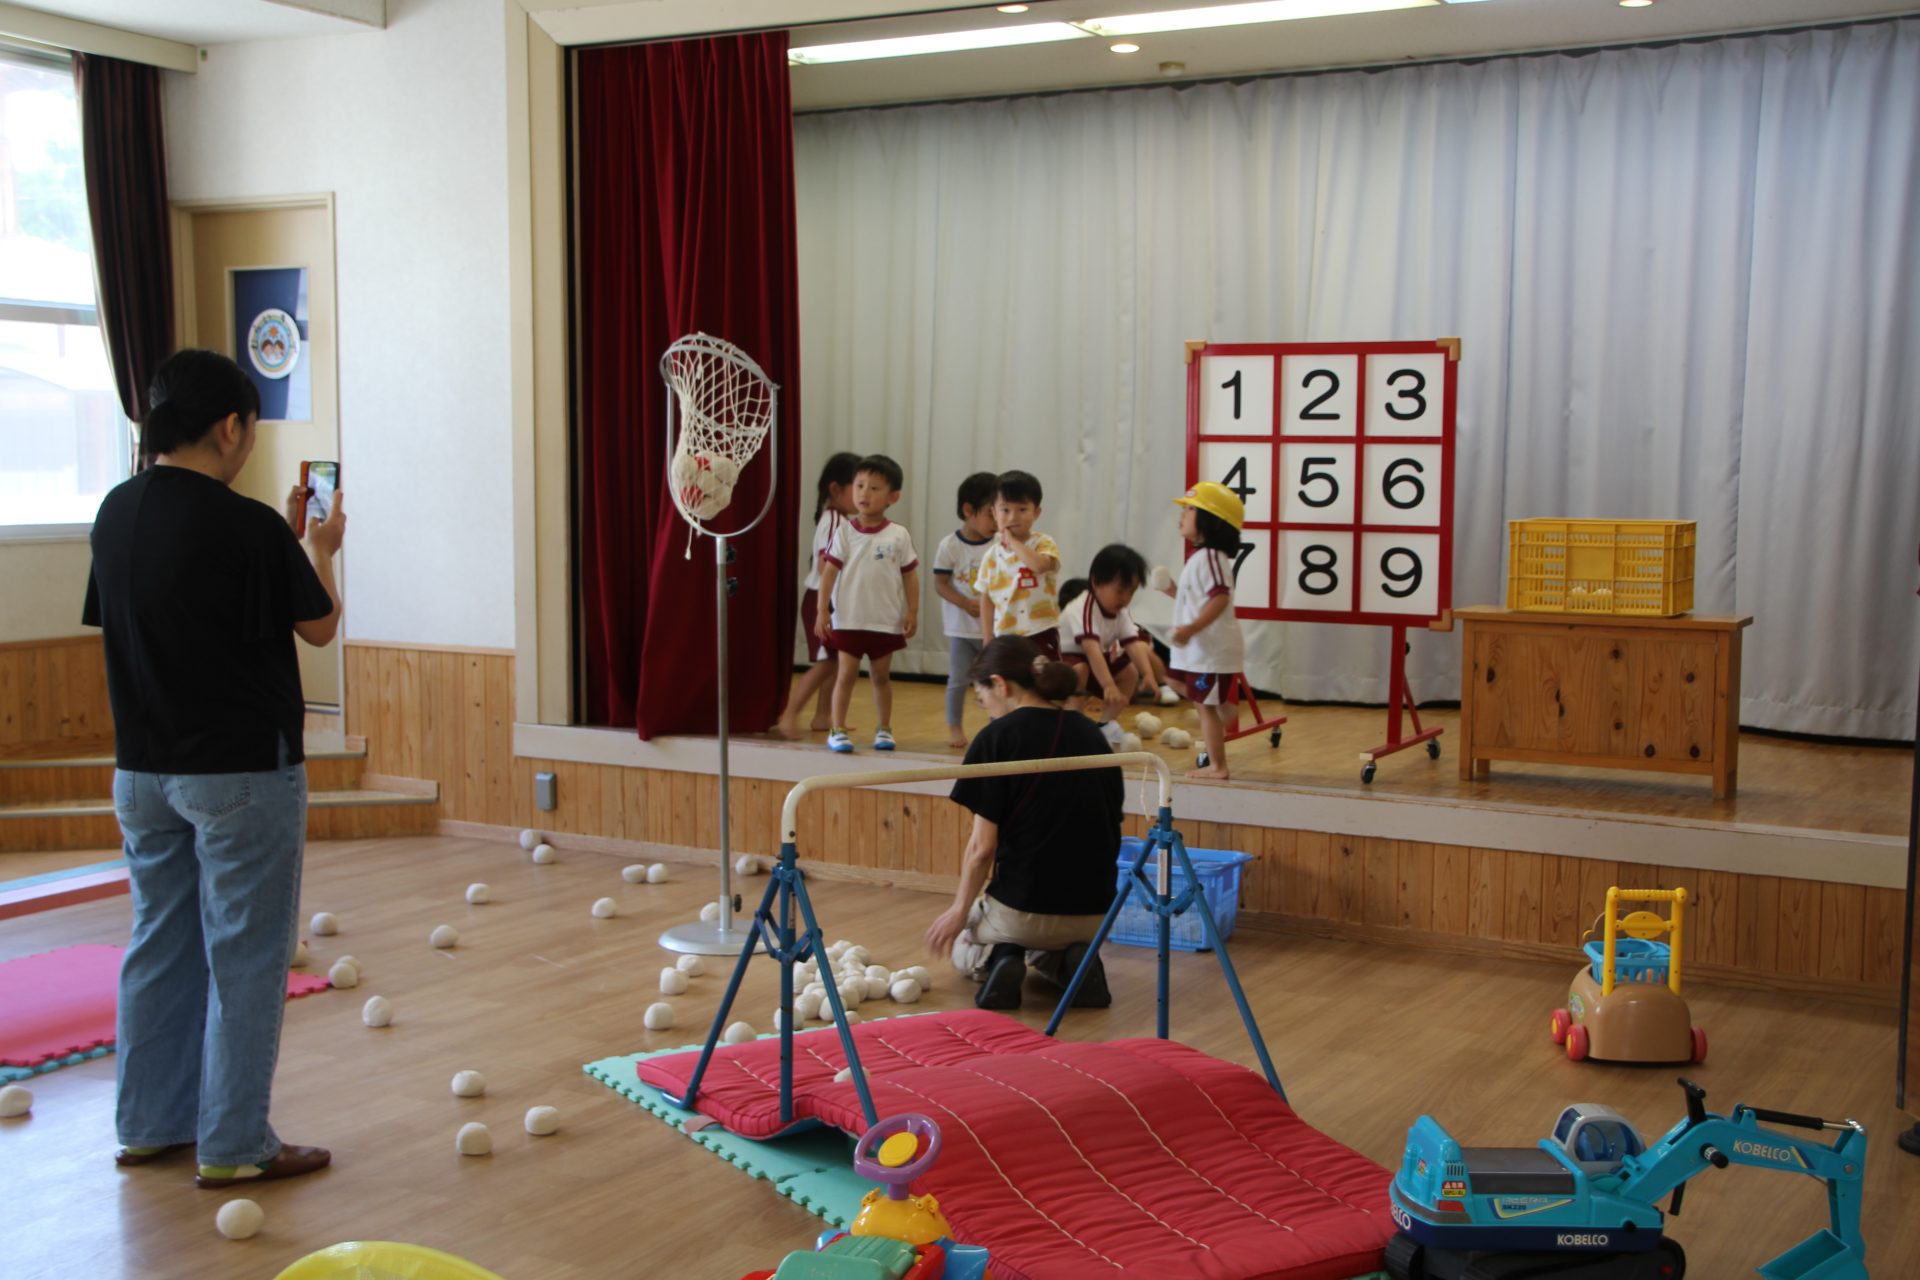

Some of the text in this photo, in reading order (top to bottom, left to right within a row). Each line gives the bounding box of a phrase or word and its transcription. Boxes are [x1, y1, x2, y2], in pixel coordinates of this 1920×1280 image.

[1221, 369, 1427, 421] 1 2 3
[1220, 456, 1425, 509] 4 5 6
[1298, 544, 1338, 595] 8
[1380, 547, 1423, 598] 9
[1733, 1140, 1791, 1162] KOBELCO
[1556, 1234, 1609, 1246] KOBELCO
